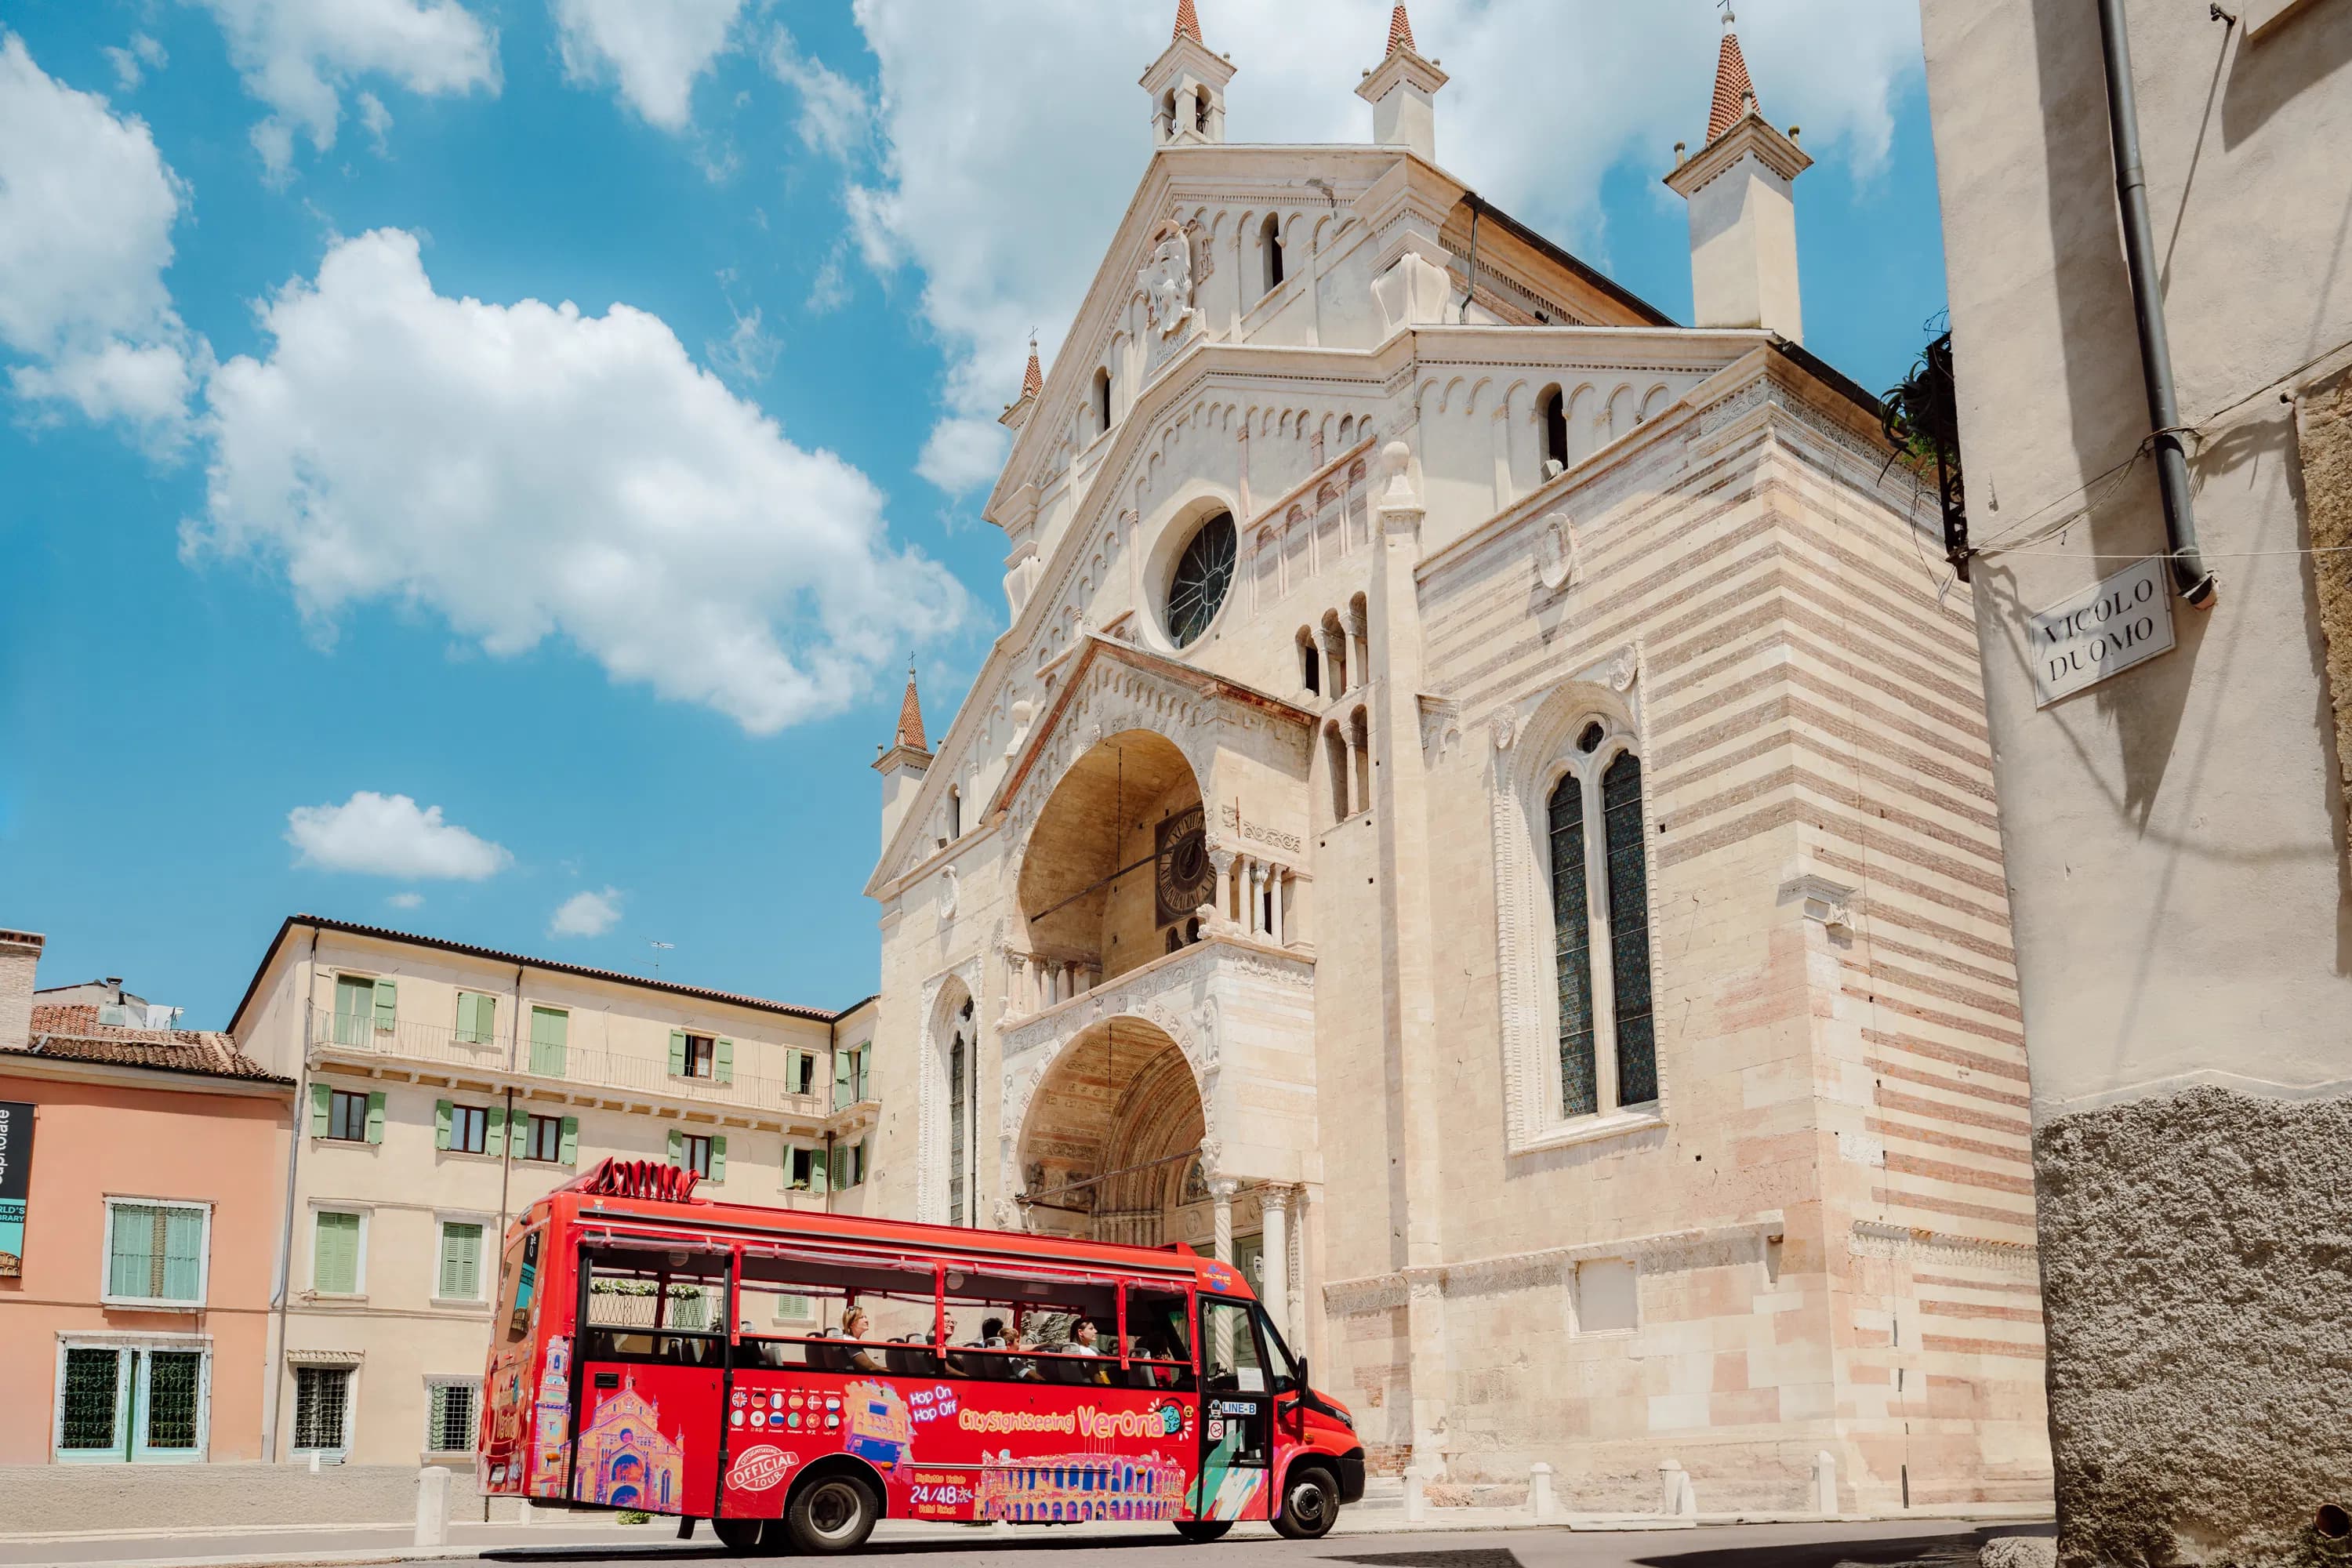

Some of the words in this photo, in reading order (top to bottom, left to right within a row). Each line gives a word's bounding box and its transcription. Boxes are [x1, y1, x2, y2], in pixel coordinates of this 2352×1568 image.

[2043, 579, 2154, 644] VICOLO
[2049, 616, 2154, 682] DUOMO
[910, 1392, 933, 1406] Hop
[935, 1385, 952, 1399] On
[913, 1408, 937, 1423] Hop
[939, 1400, 956, 1416] Off
[733, 1454, 795, 1484] OFFICIAL
[754, 1471, 782, 1487] TOUR
[909, 1486, 957, 1504] 24/48
